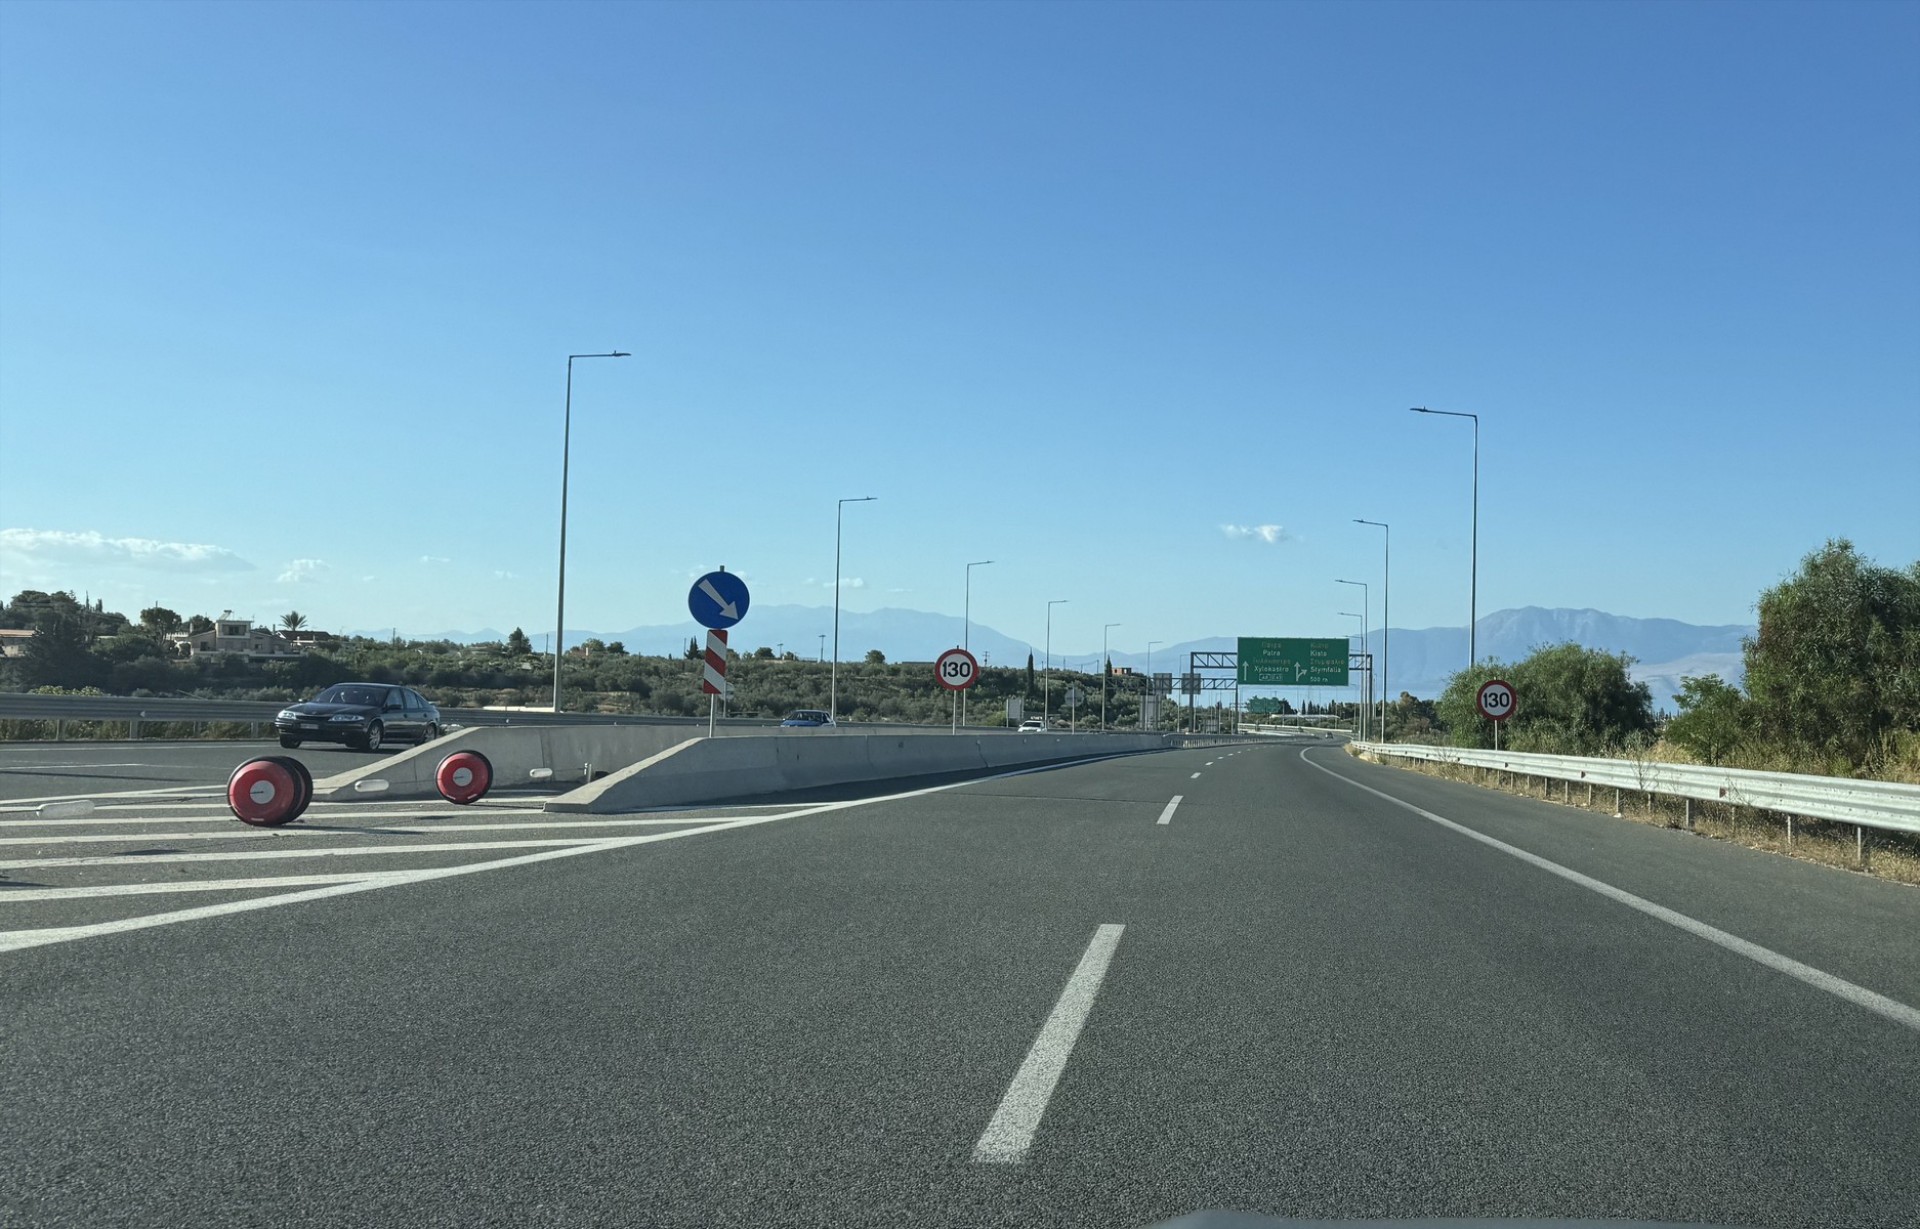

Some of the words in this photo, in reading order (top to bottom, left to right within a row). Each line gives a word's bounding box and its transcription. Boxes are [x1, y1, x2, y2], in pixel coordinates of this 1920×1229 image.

[942, 661, 971, 678] 130
[1254, 665, 1289, 673] Xylokastro
[1310, 666, 1341, 674] Stymfalia
[1483, 692, 1510, 708] 130
